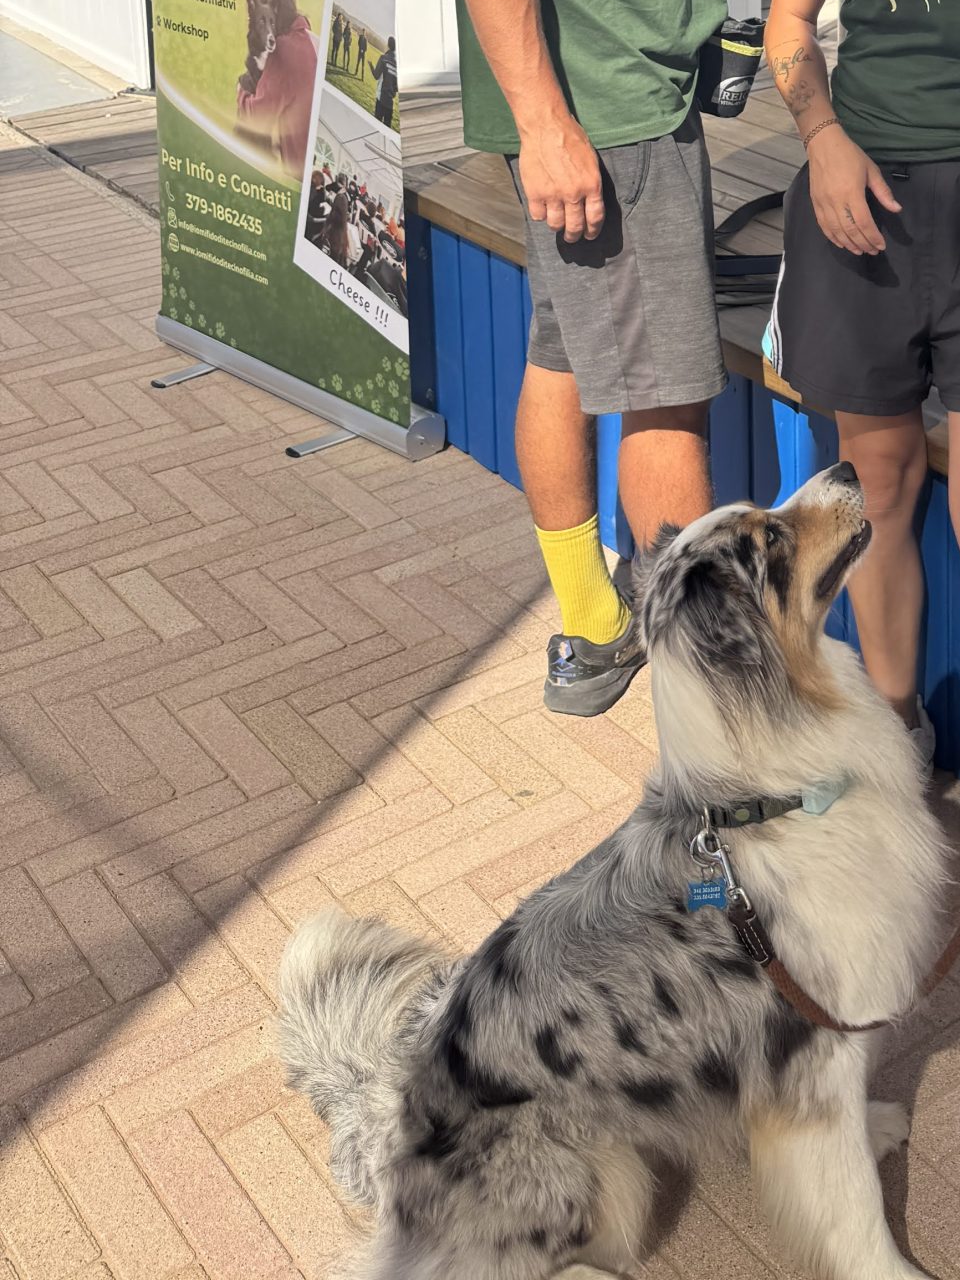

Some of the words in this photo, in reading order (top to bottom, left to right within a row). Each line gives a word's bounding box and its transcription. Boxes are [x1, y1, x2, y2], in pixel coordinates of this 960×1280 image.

[163, 18, 209, 41] Workshop
[161, 148, 182, 172] Per
[186, 158, 214, 183] Info
[218, 173, 227, 188] e
[231, 174, 291, 212] Contatti
[185, 192, 263, 235] 379-1862435
[329, 269, 371, 313] Cheese
[375, 305, 388, 328] !!!
